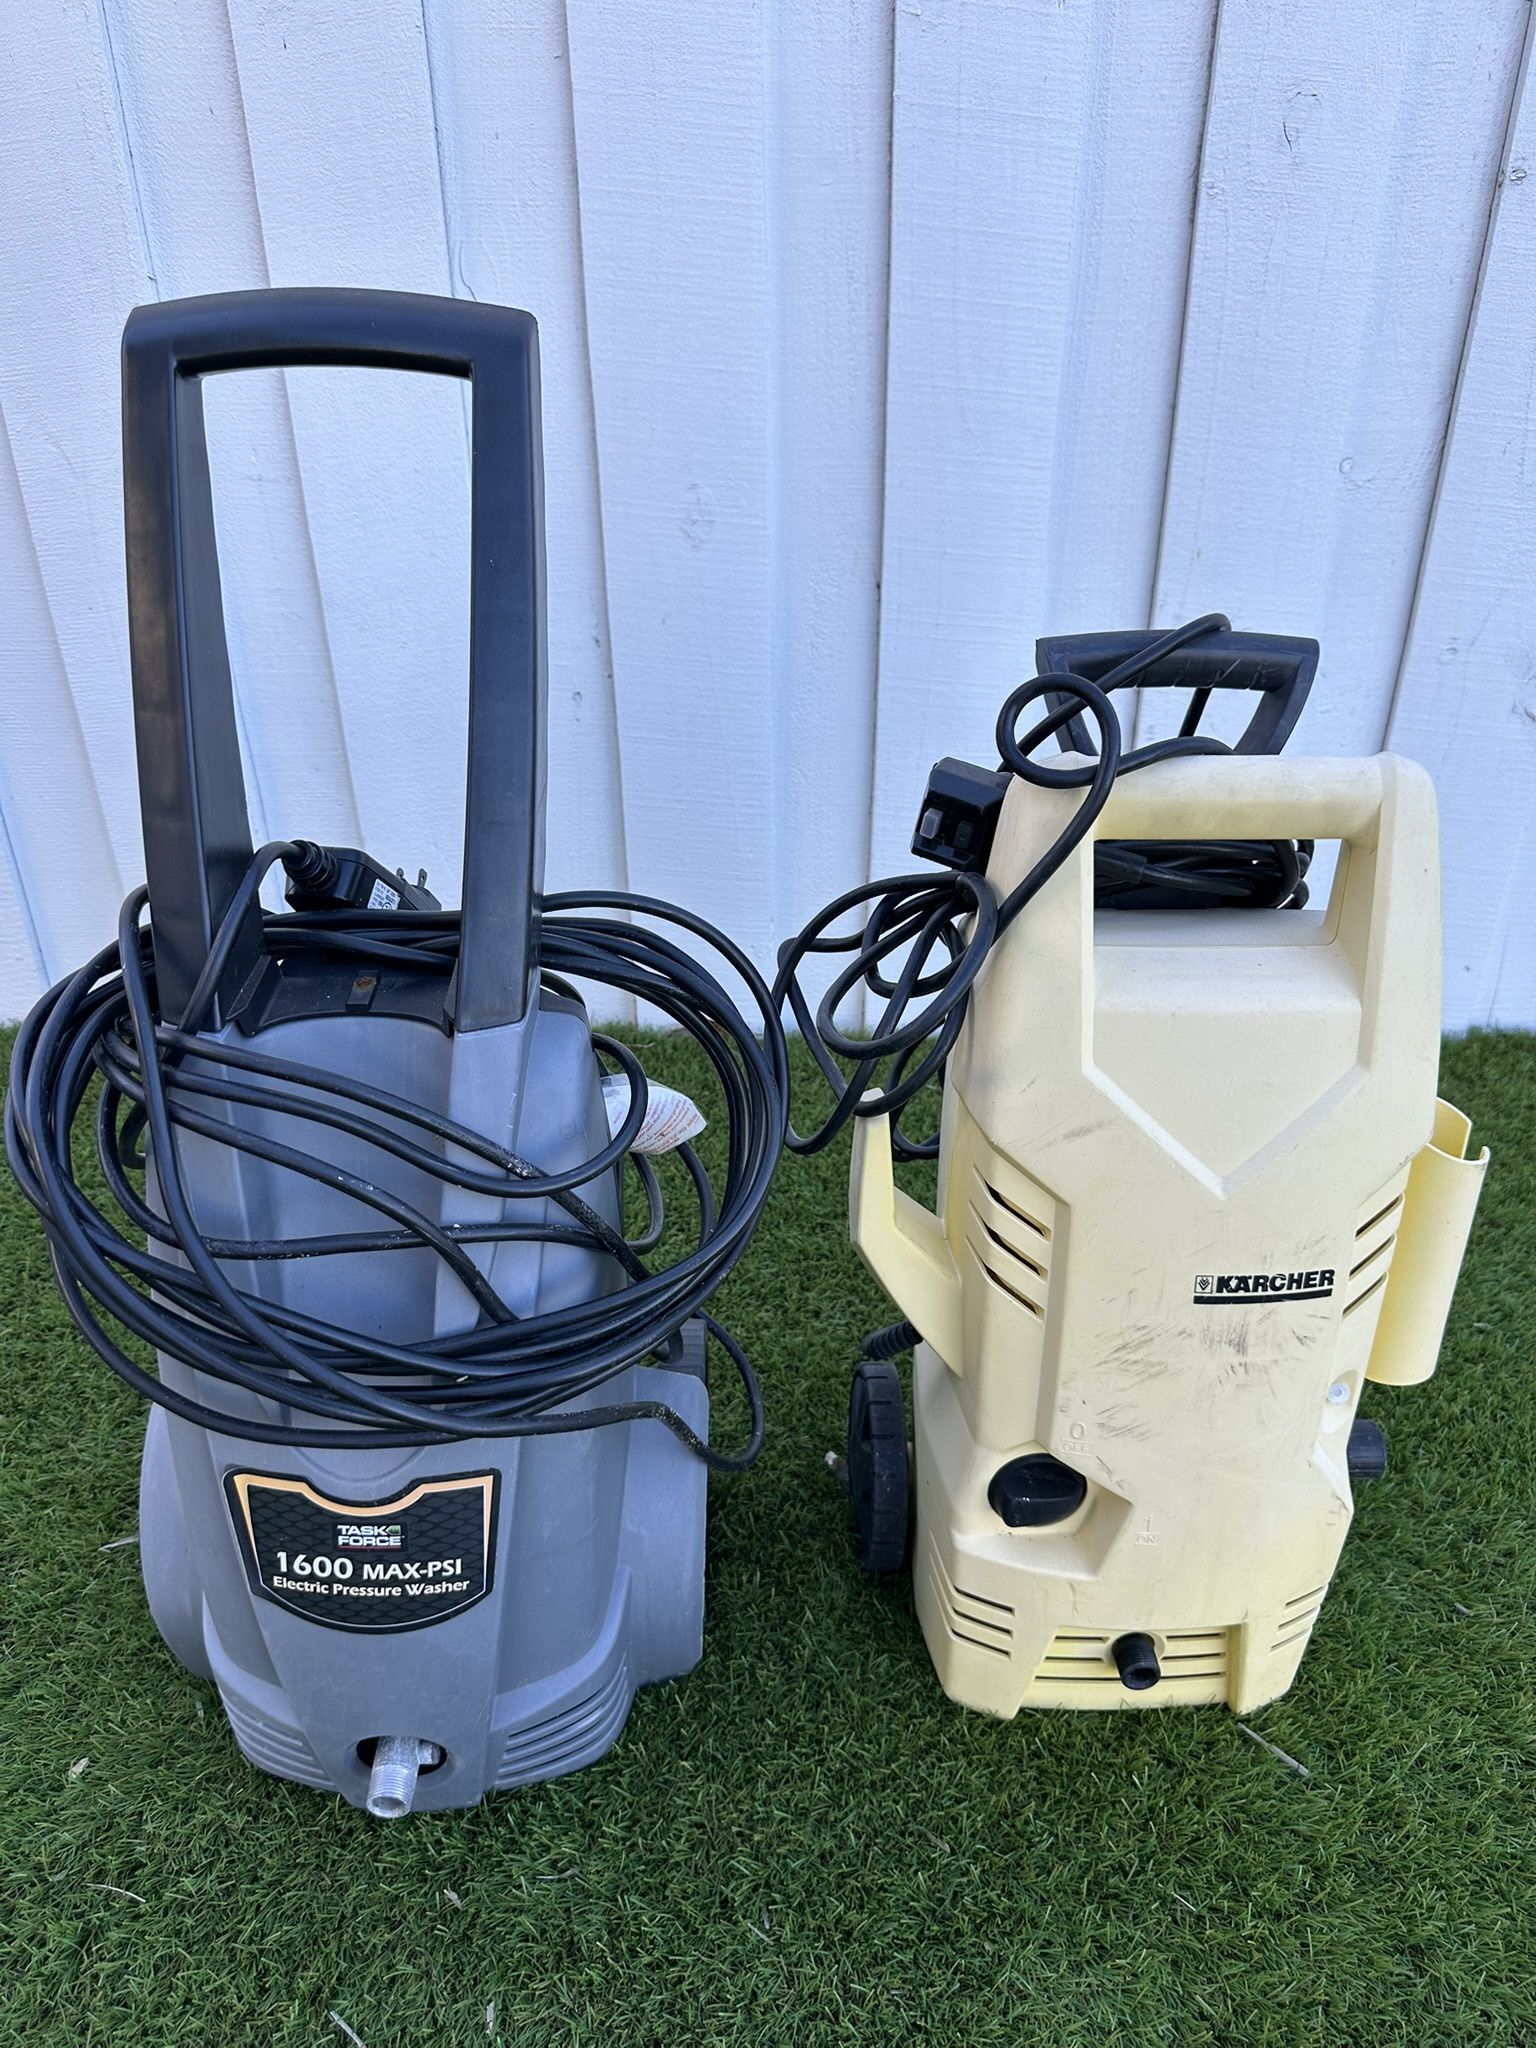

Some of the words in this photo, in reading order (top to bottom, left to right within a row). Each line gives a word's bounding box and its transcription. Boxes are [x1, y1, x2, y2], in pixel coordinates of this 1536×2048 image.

[1215, 1269, 1335, 1293] KÄRCHER
[1062, 1441, 1090, 1452] OFF
[337, 1525, 388, 1536] TASK
[338, 1535, 402, 1546] FORCE
[1136, 1535, 1157, 1544] ON
[276, 1551, 354, 1580] 1600
[362, 1558, 462, 1581] MAX-PSI
[272, 1576, 330, 1594] Electric
[332, 1583, 402, 1597] Pressure
[405, 1579, 470, 1596] Washer
